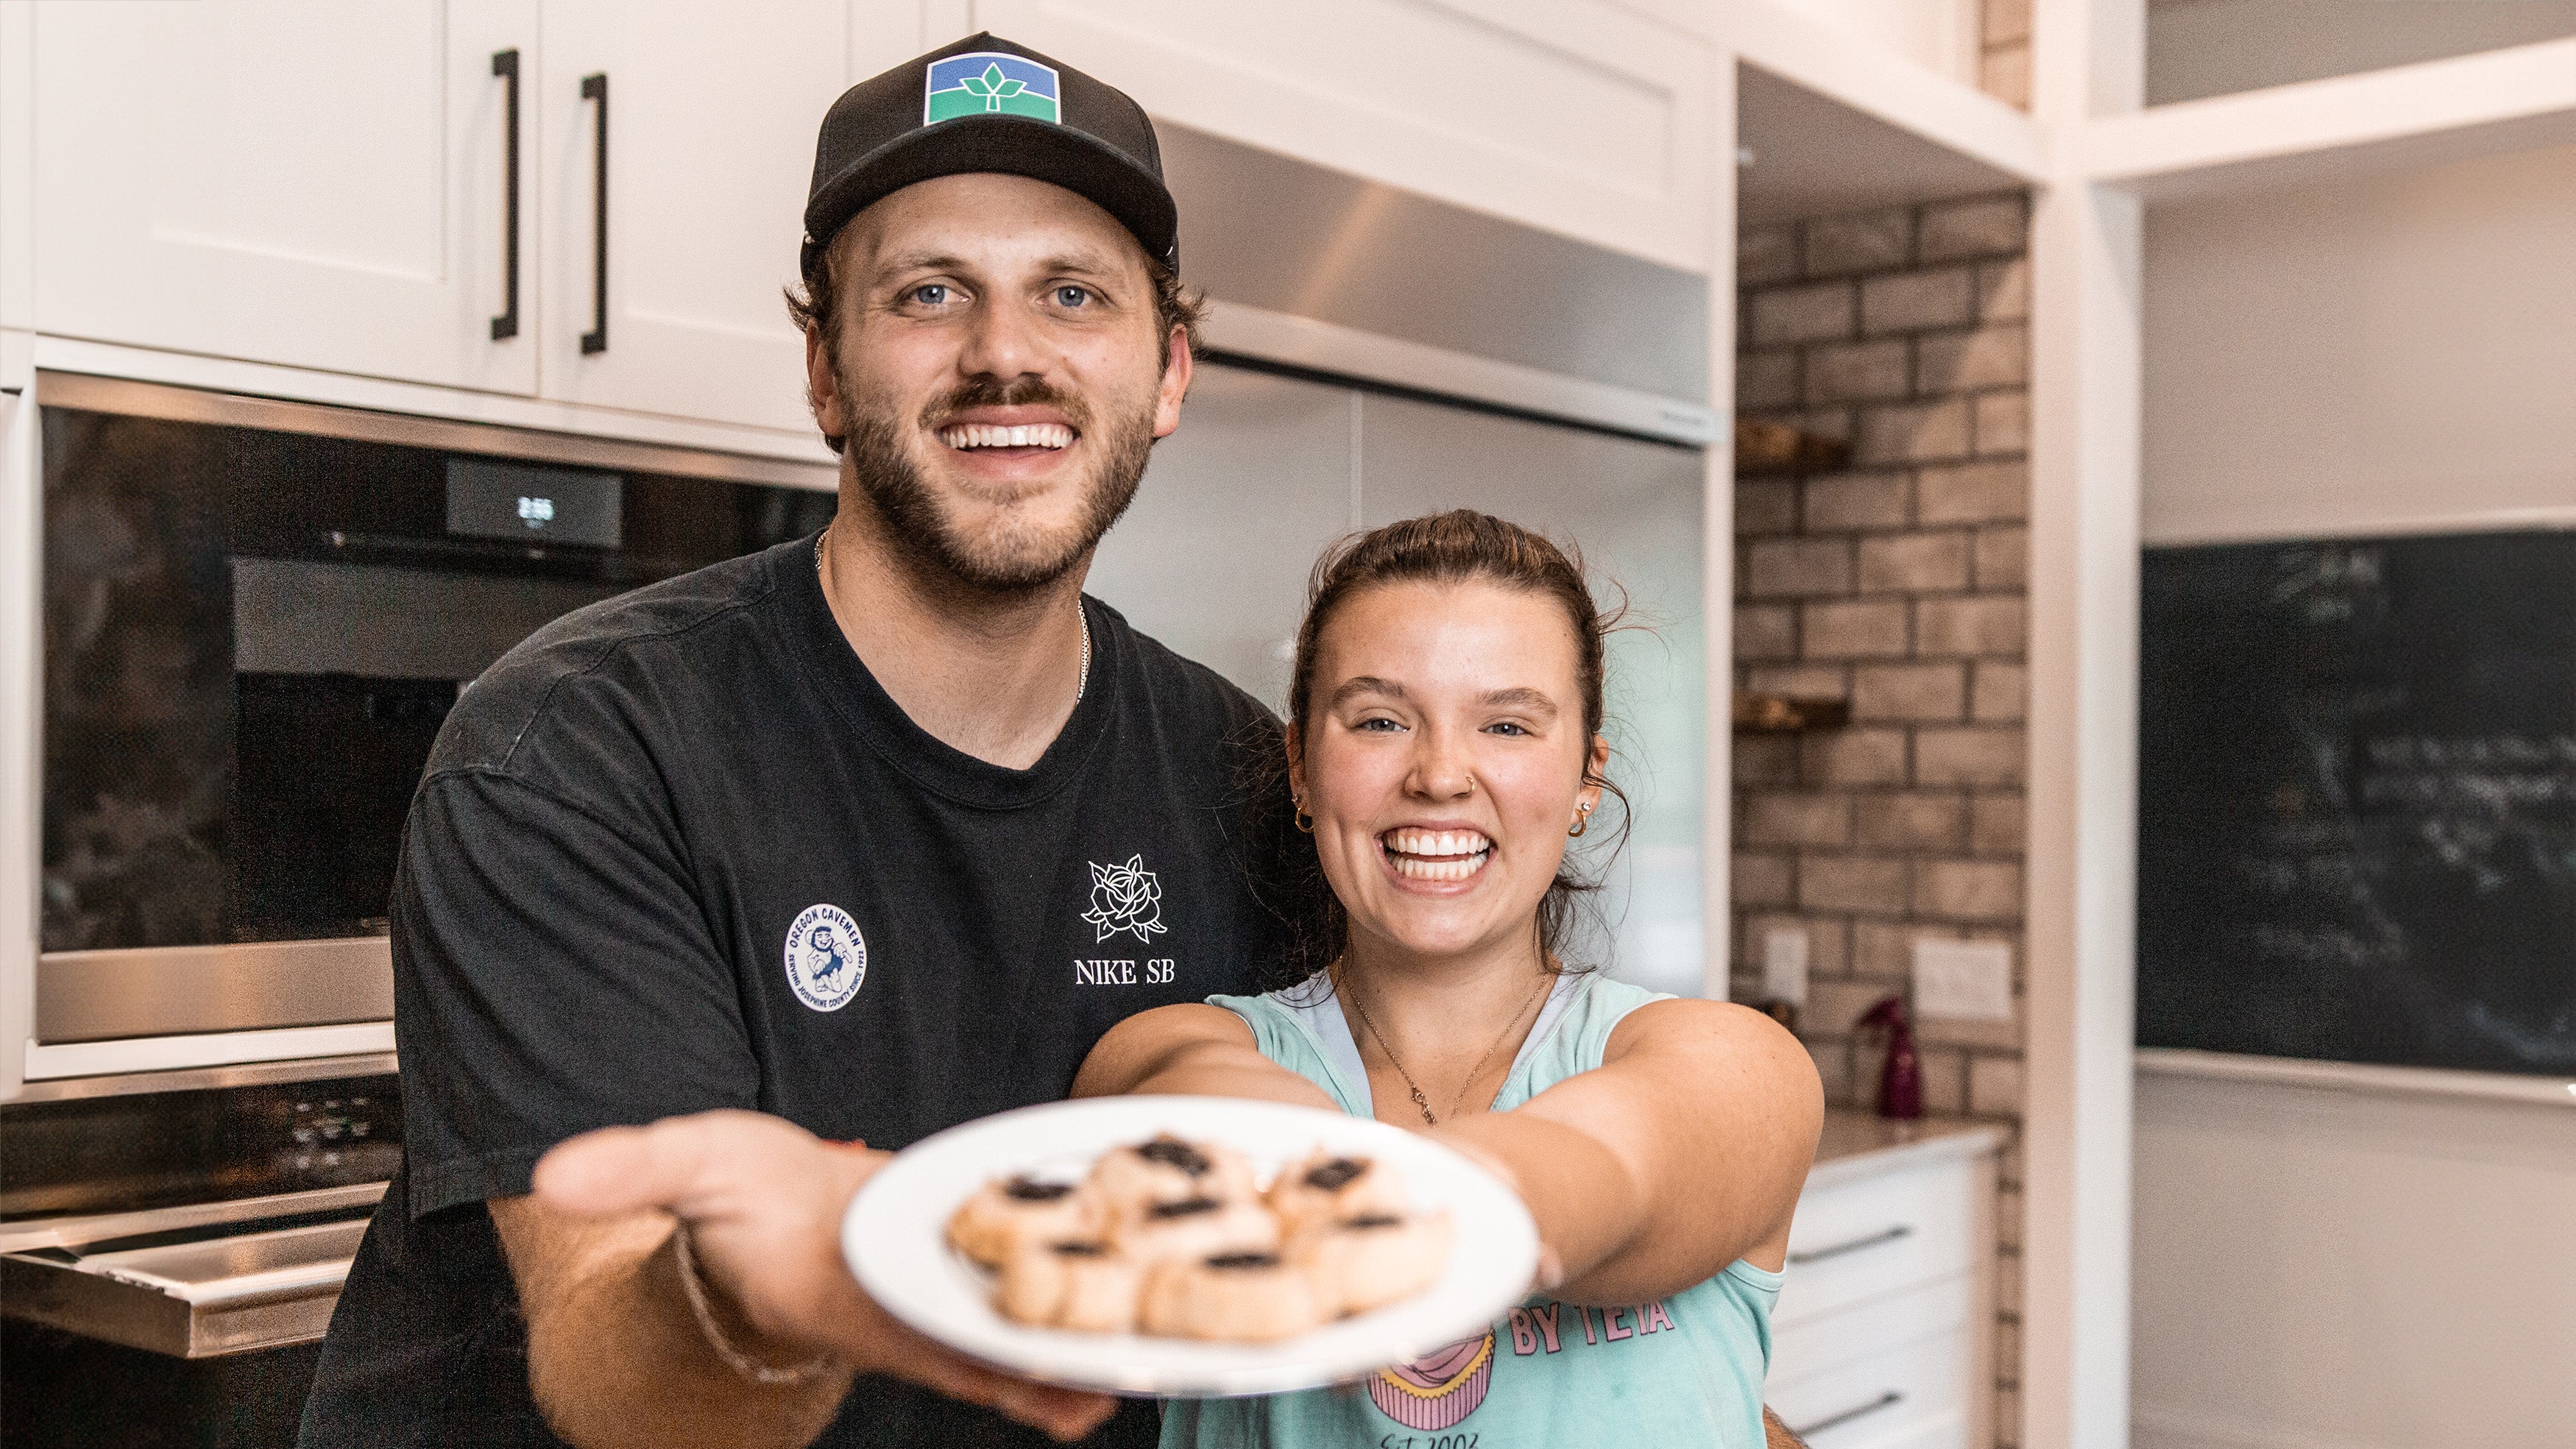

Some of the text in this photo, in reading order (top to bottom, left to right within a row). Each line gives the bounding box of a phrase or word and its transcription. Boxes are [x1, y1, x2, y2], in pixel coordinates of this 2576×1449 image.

[790, 907, 860, 949] OREGON CAVEMEN
[788, 953, 802, 986] SERVING
[798, 986, 827, 1007] JOSEPHINE
[829, 989, 851, 1007] COUNTY
[849, 971, 862, 992] SINCE
[1074, 959, 1175, 985] NIKE SB
[1508, 1300, 1675, 1356] BY TEYA
